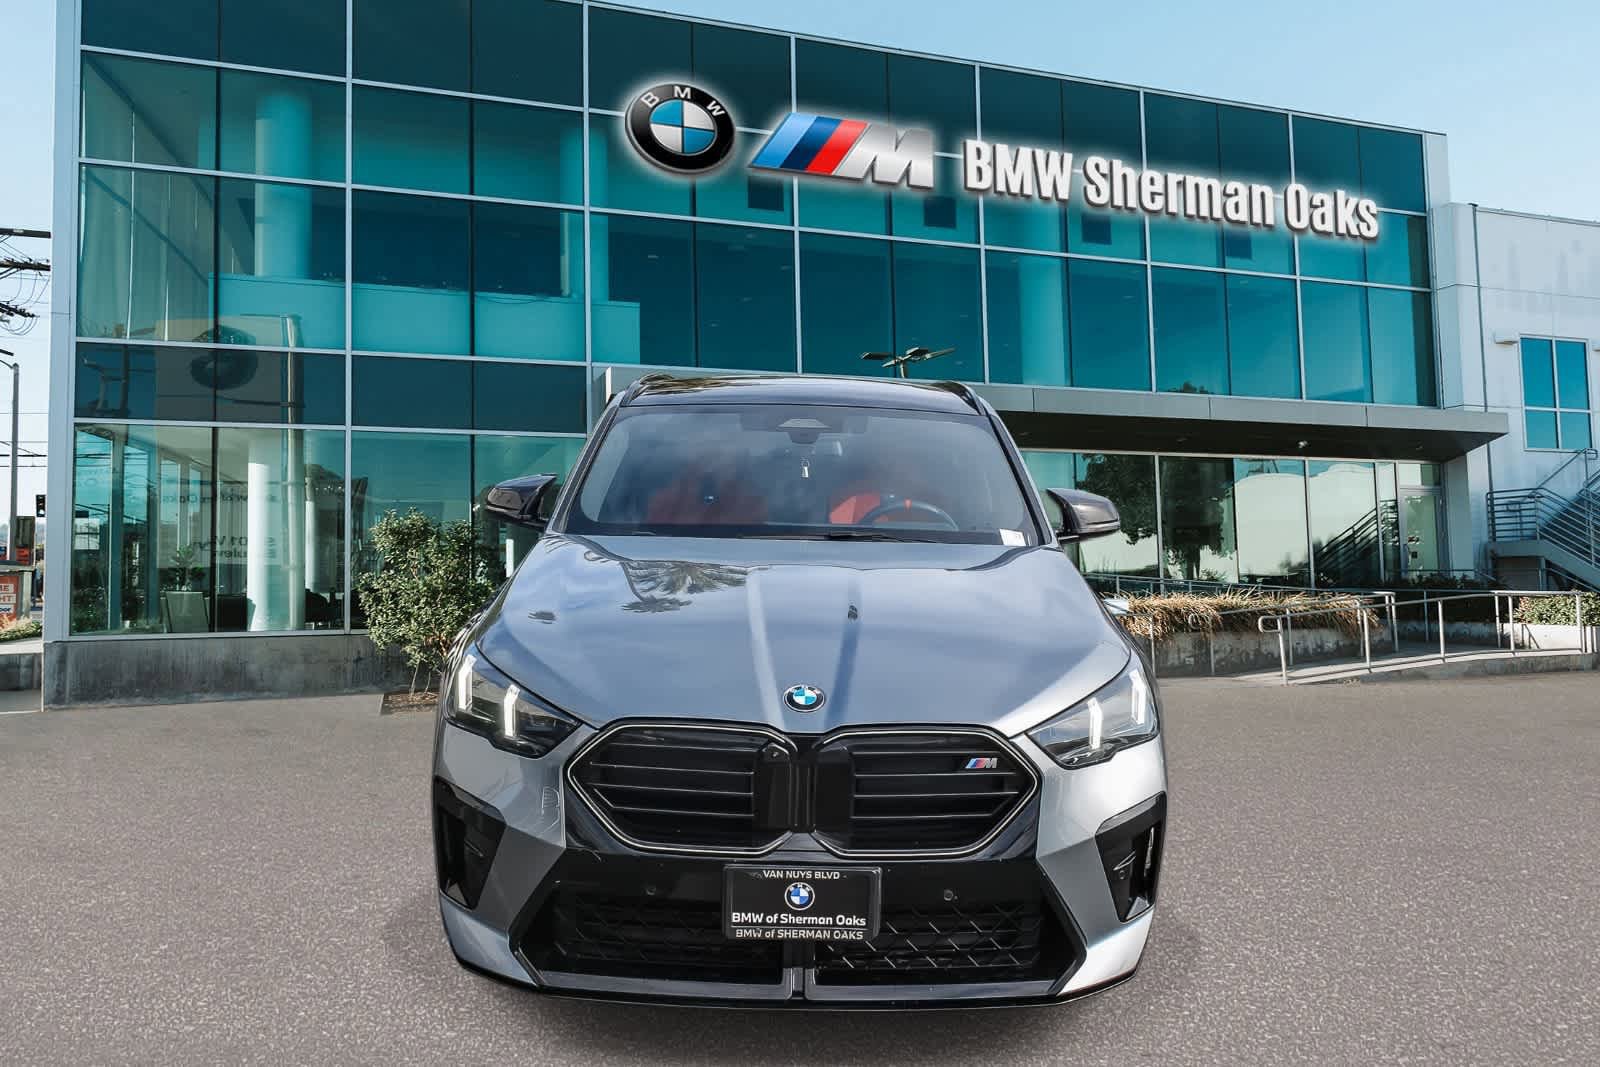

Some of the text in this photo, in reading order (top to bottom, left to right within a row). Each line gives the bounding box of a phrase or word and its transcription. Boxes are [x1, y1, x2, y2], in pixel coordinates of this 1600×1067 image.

[641, 85, 726, 117] BMW
[832, 121, 935, 189] M
[964, 140, 1379, 239] BMW Sherman Oaks
[762, 870, 840, 880] VAN NUYS BLVD
[731, 912, 866, 927] BMW of Sherman Oaks
[736, 928, 863, 940] BMW of SHERMAN OAKS
